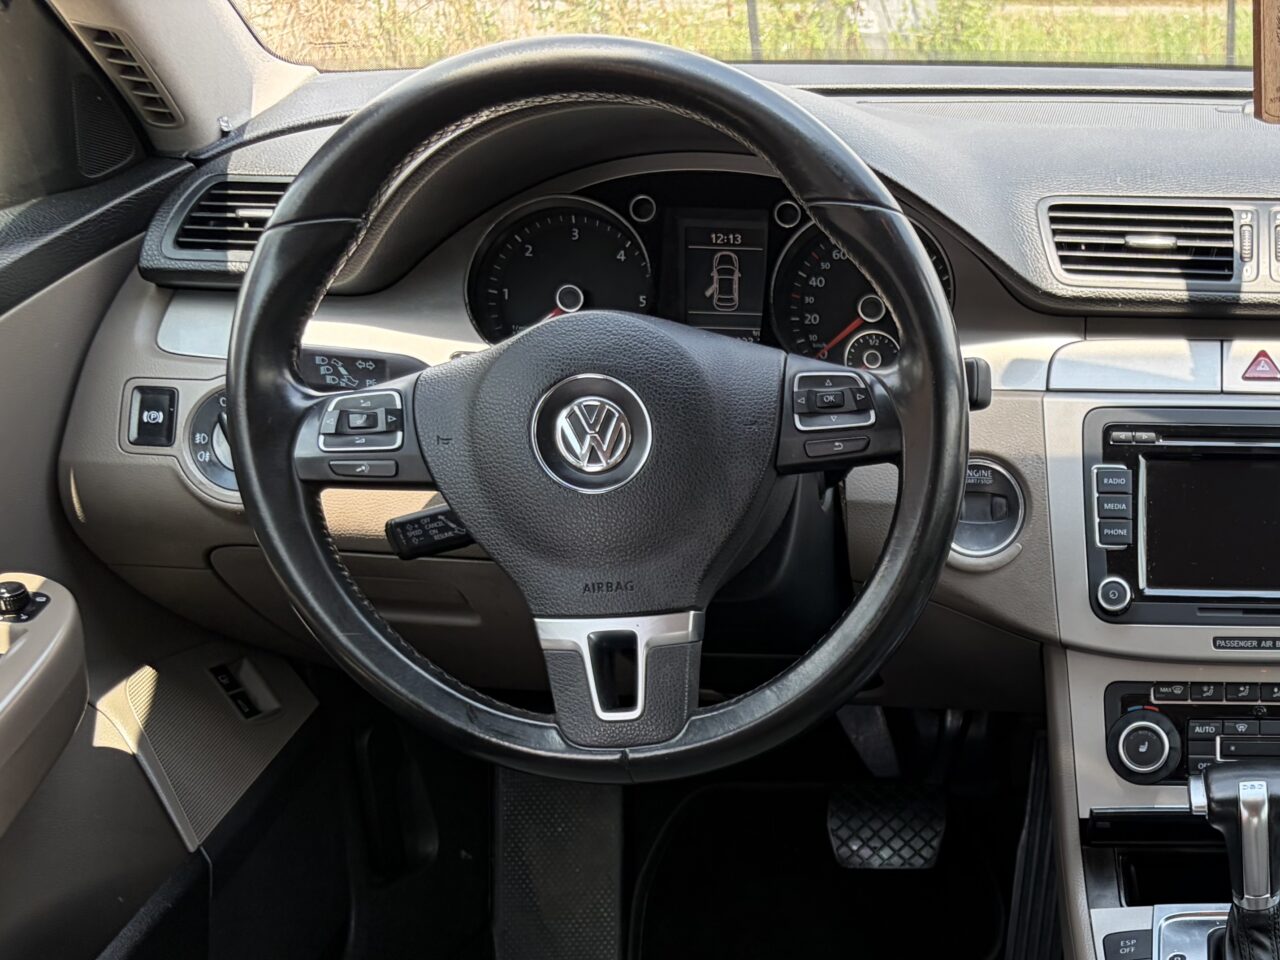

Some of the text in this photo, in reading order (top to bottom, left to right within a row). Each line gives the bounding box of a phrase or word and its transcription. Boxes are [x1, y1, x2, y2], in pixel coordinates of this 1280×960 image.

[571, 228, 579, 240] 3
[710, 233, 742, 244] 12:13
[524, 245, 533, 257] 2
[616, 250, 626, 261] 4
[832, 250, 848, 260] 60
[809, 277, 825, 287] 40
[502, 288, 509, 300] 1
[639, 295, 647, 307] 5
[804, 314, 820, 325] 20
[823, 395, 836, 403] OK
[967, 469, 993, 477] NGINE
[582, 580, 634, 594] AIRBAG
[1216, 640, 1258, 648] PASSENGER
[1260, 640, 1273, 648] AIR
[1120, 939, 1137, 947] ESP
[1119, 946, 1136, 954] OFF
